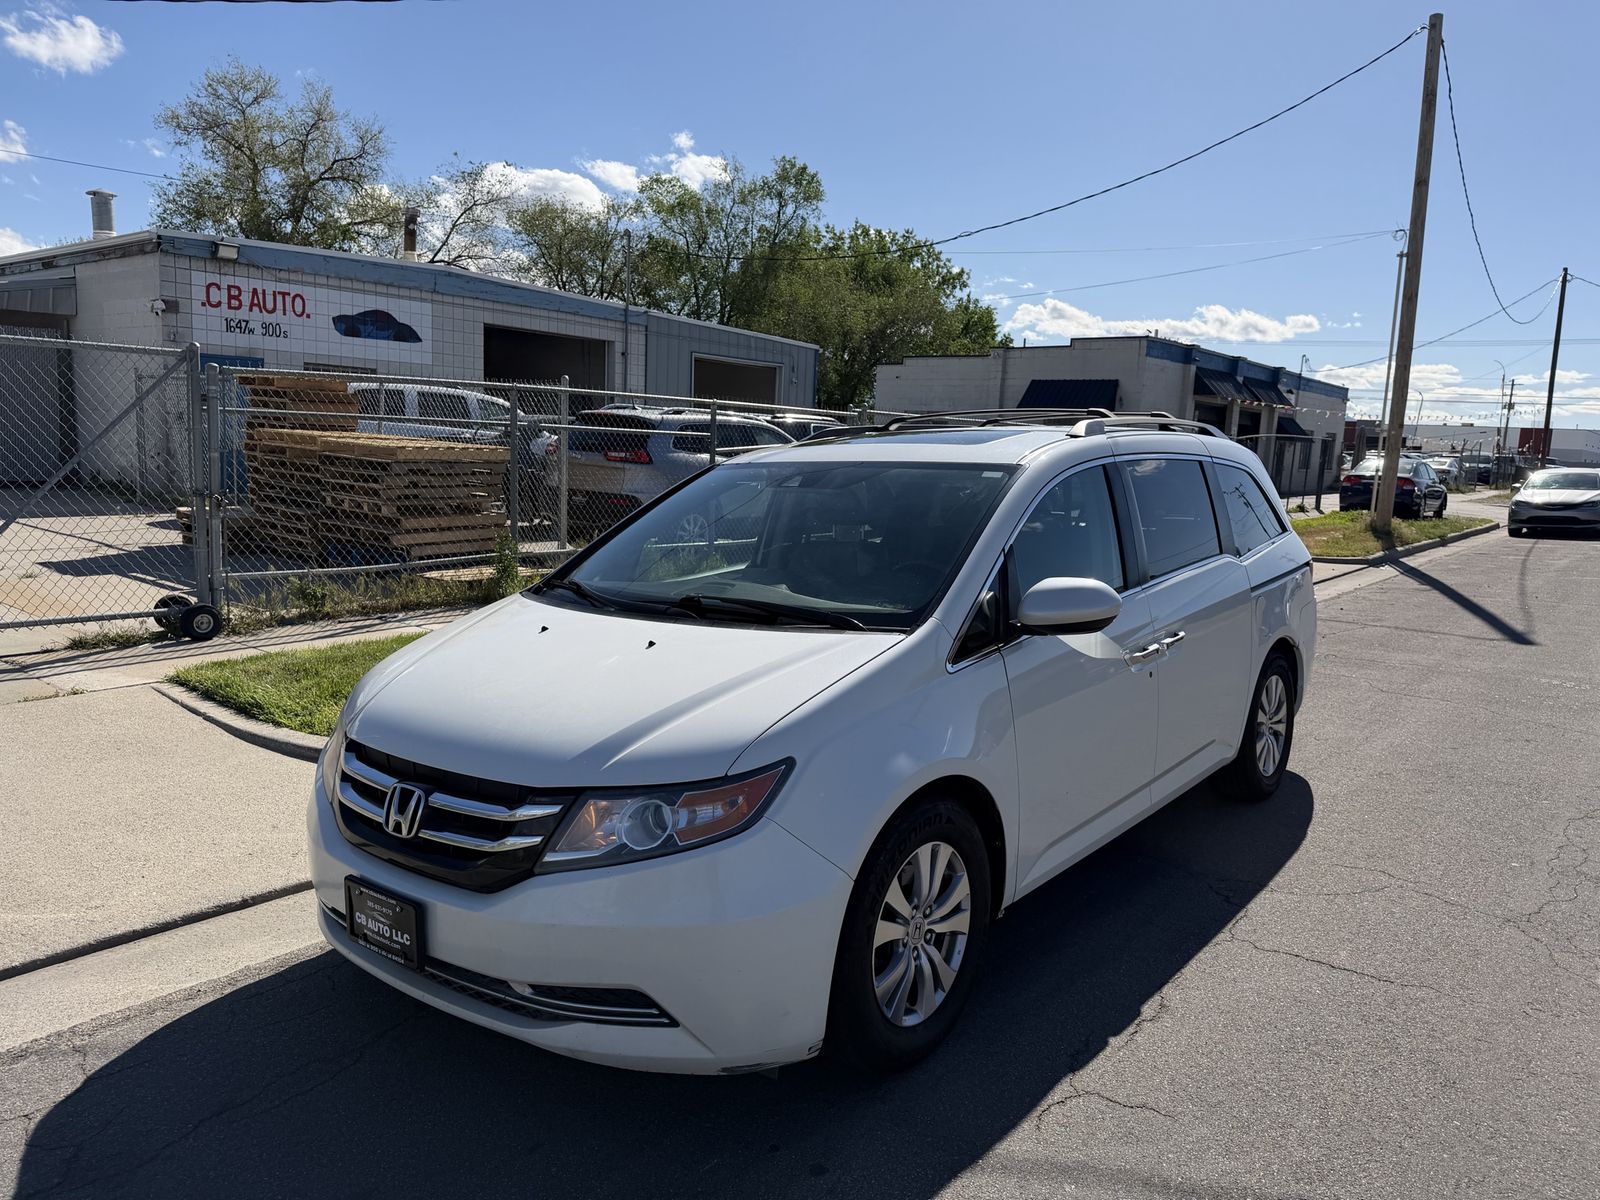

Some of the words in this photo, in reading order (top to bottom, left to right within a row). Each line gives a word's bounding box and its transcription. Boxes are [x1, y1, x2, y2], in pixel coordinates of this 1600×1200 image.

[355, 911, 367, 926] CB
[367, 918, 390, 937] AUTO
[392, 928, 410, 946] LLC
